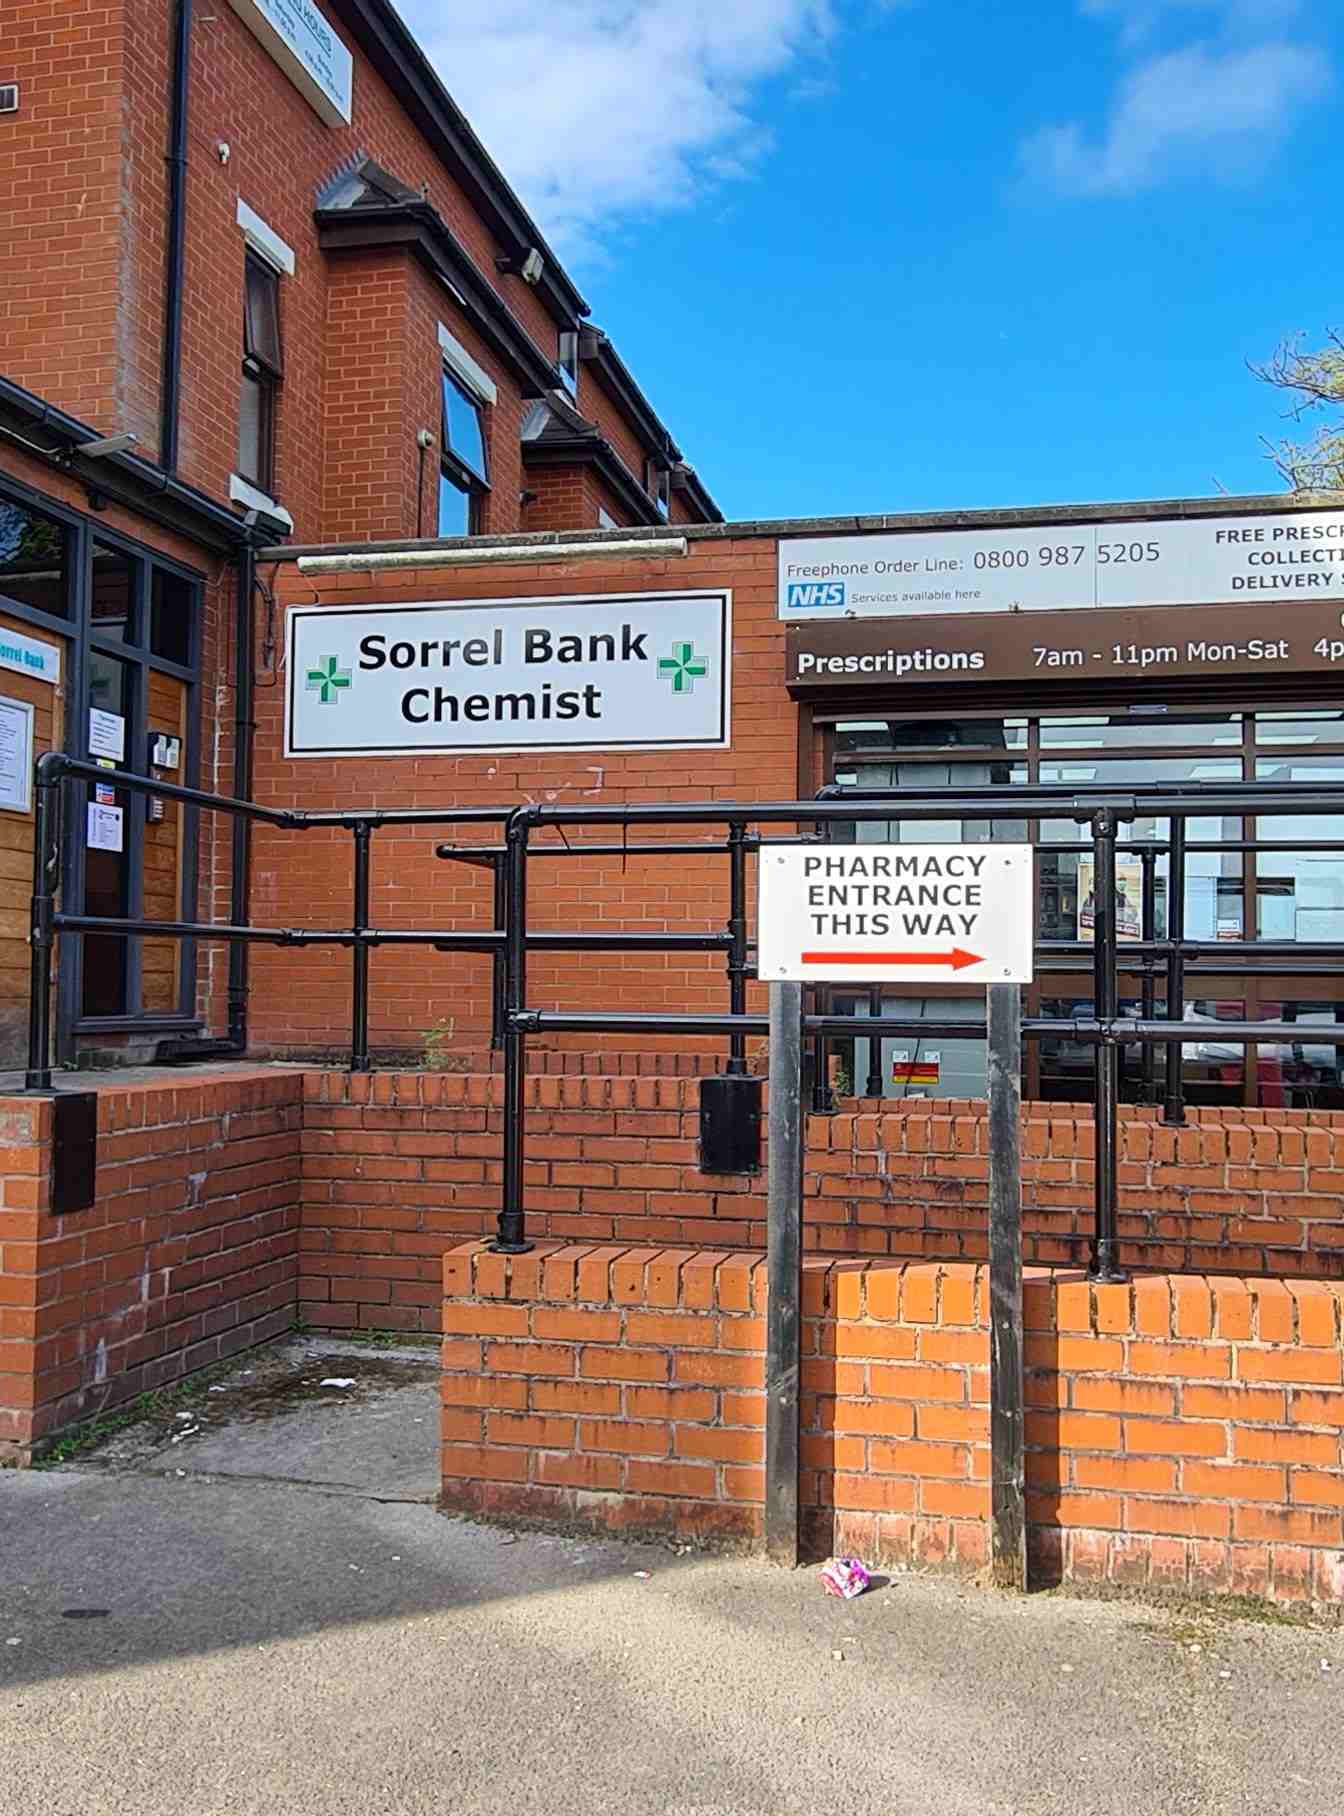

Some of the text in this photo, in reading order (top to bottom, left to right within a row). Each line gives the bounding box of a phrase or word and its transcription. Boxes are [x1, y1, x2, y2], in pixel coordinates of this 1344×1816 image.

[1215, 528, 1265, 544] FREE
[787, 542, 1160, 578] Freephone Order Line: 0800 987 5205
[1231, 572, 1335, 590] DELIVERY
[789, 583, 982, 607] NHS Services available here
[358, 623, 649, 671] Sorrel Bank
[797, 648, 985, 677] Prescriptions
[1033, 647, 1083, 667] 7am
[1111, 643, 1178, 668] 11pm
[1187, 639, 1289, 662] Mon-Sat
[400, 683, 602, 723] Chemist
[804, 855, 987, 878] PHARMACY
[808, 884, 982, 907] ENTRANCE
[810, 913, 979, 936] THIS WAY
